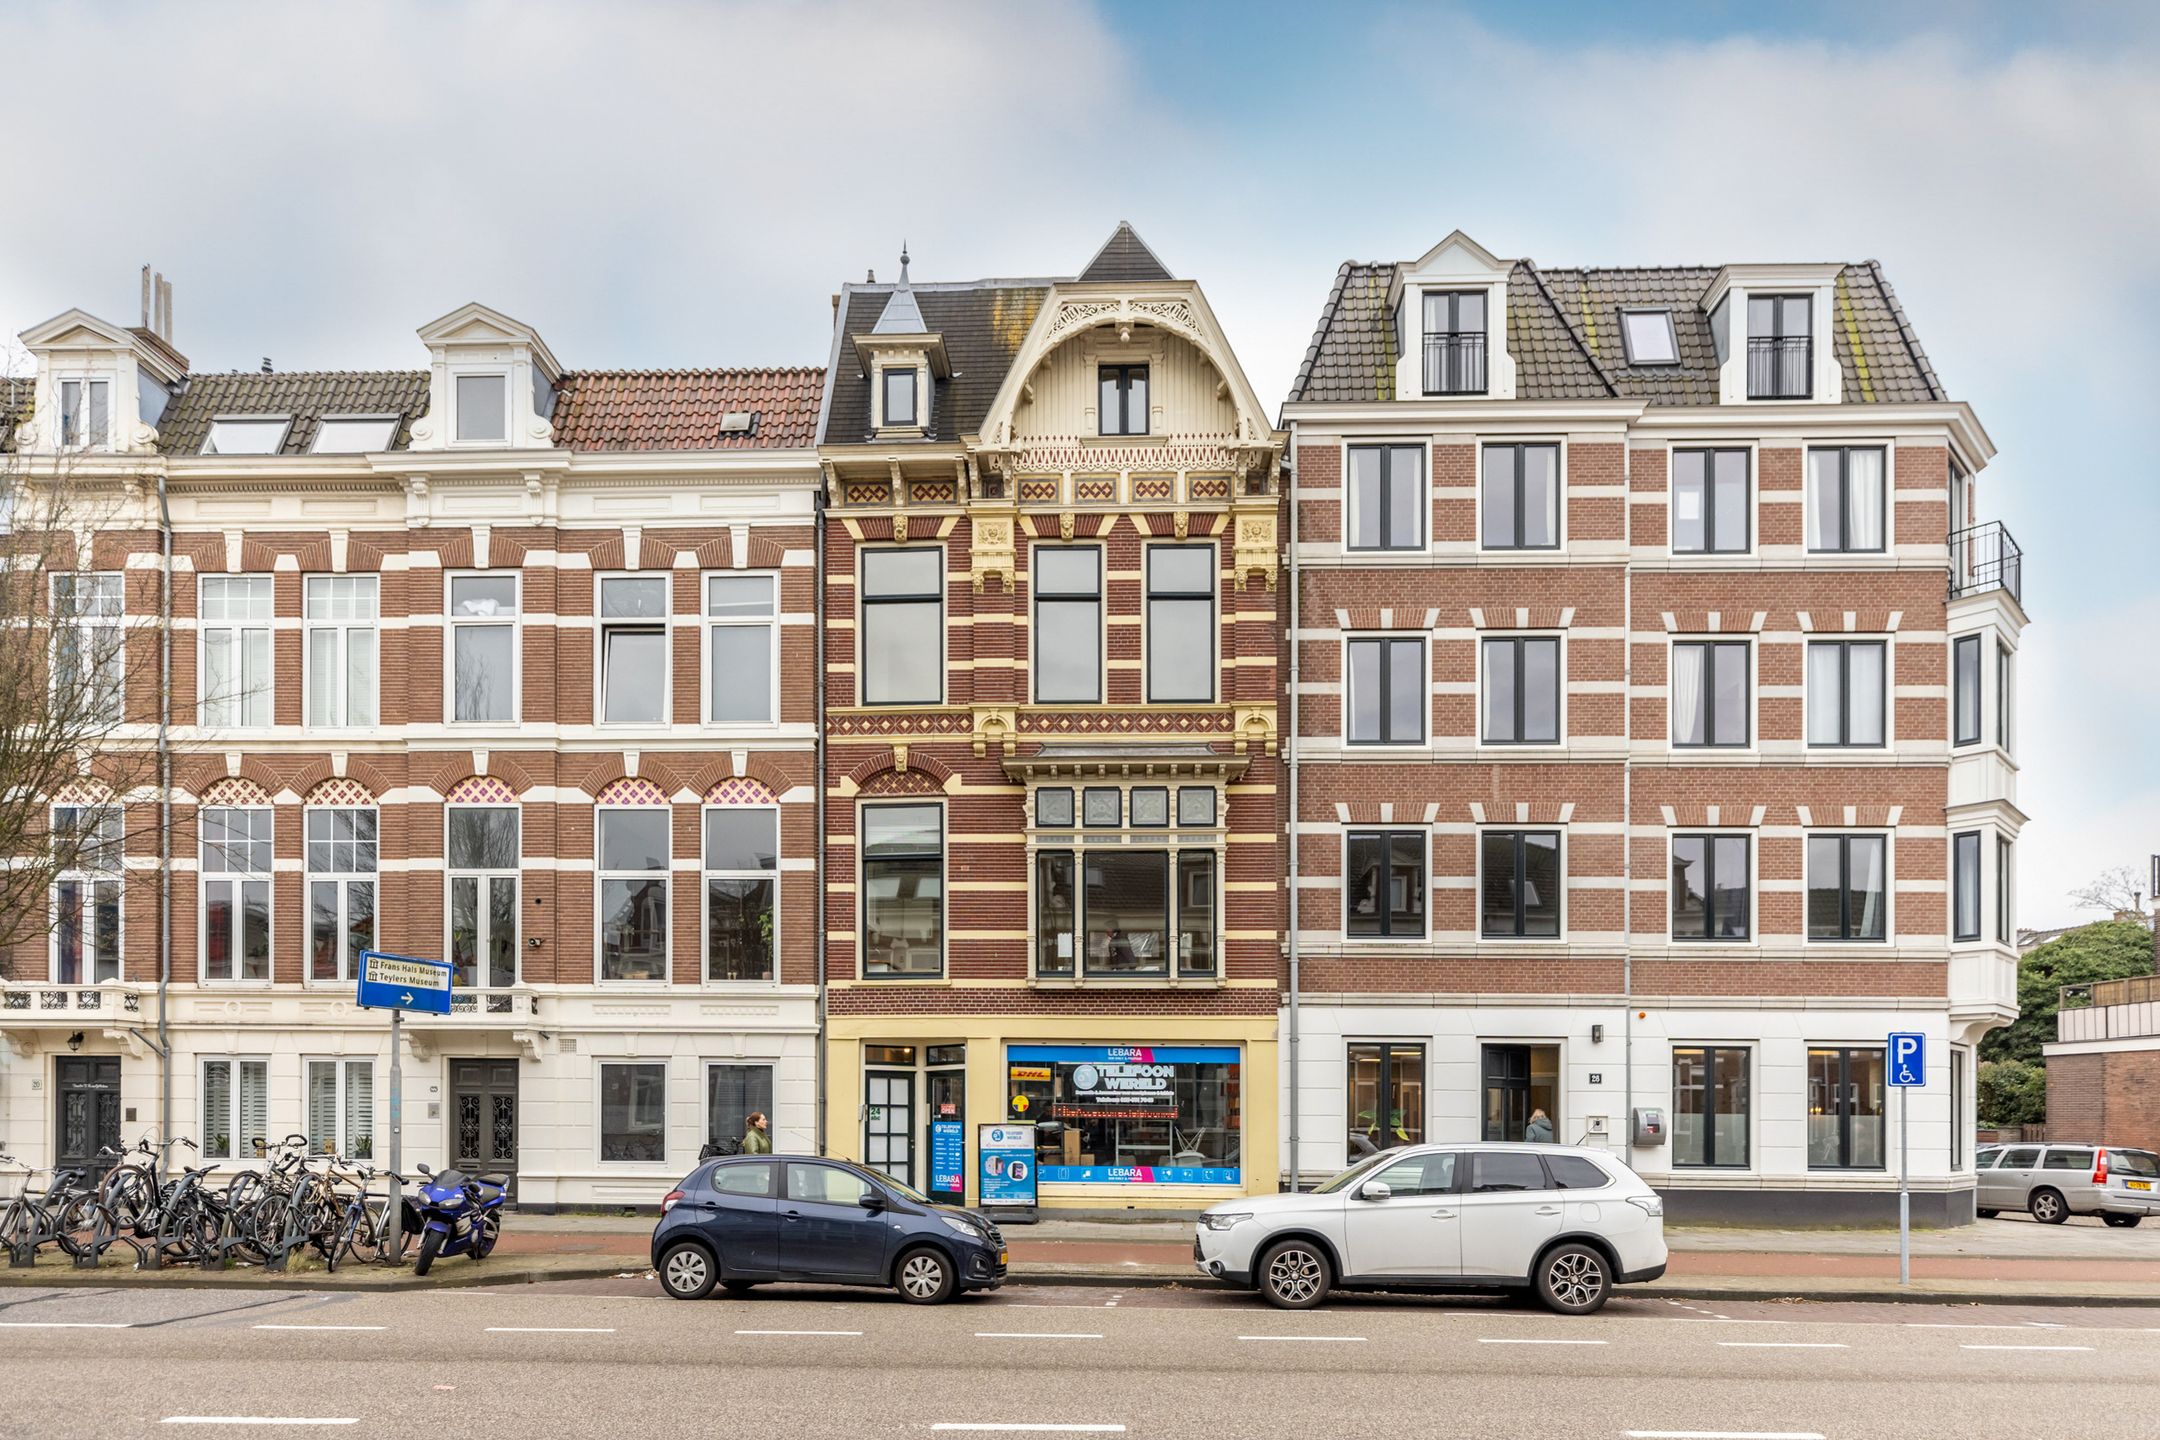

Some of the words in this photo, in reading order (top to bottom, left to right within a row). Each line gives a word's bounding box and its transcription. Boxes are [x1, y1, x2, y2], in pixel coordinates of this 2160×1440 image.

[380, 961, 400, 971] Frans
[402, 964, 417, 973] Hals
[419, 966, 447, 977] Museum
[379, 972, 407, 983] Teylers
[409, 976, 439, 987] Museum
[1108, 1048, 1142, 1057] LEBARA
[1897, 1037, 1918, 1064] P
[1097, 1064, 1174, 1077] TELEFOON
[1104, 1077, 1167, 1090] WERELD
[871, 1106, 881, 1115] 24
[935, 1174, 960, 1184] LEBARA
[1108, 1168, 1142, 1177] LEBARA
